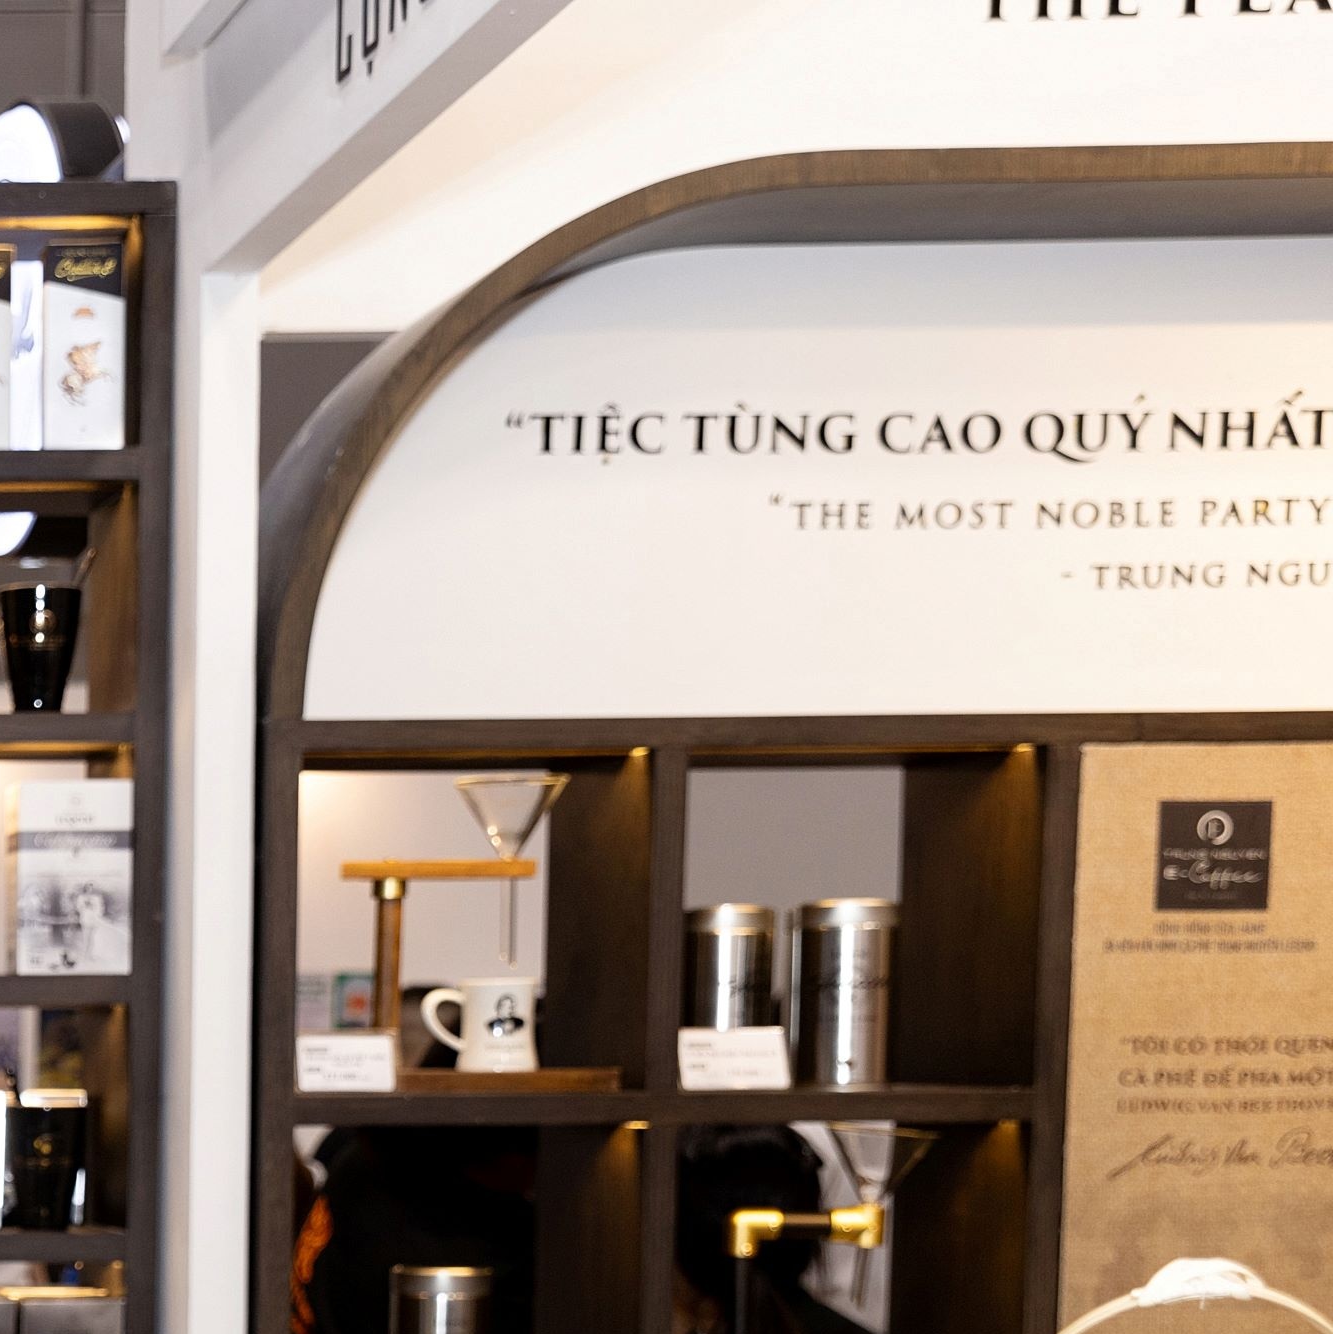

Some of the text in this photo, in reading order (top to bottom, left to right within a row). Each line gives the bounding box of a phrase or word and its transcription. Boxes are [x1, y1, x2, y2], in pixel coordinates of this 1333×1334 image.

[682, 403, 855, 455] TÙNG
[878, 411, 1003, 455] CAO
[1023, 393, 1154, 464] QUÝ
[1168, 390, 1333, 453] NHẤT
[894, 500, 1014, 531] MOST
[1035, 500, 1175, 530] NOBLE
[1199, 498, 1332, 528] PARTY
[1090, 562, 1227, 590] TRUNG
